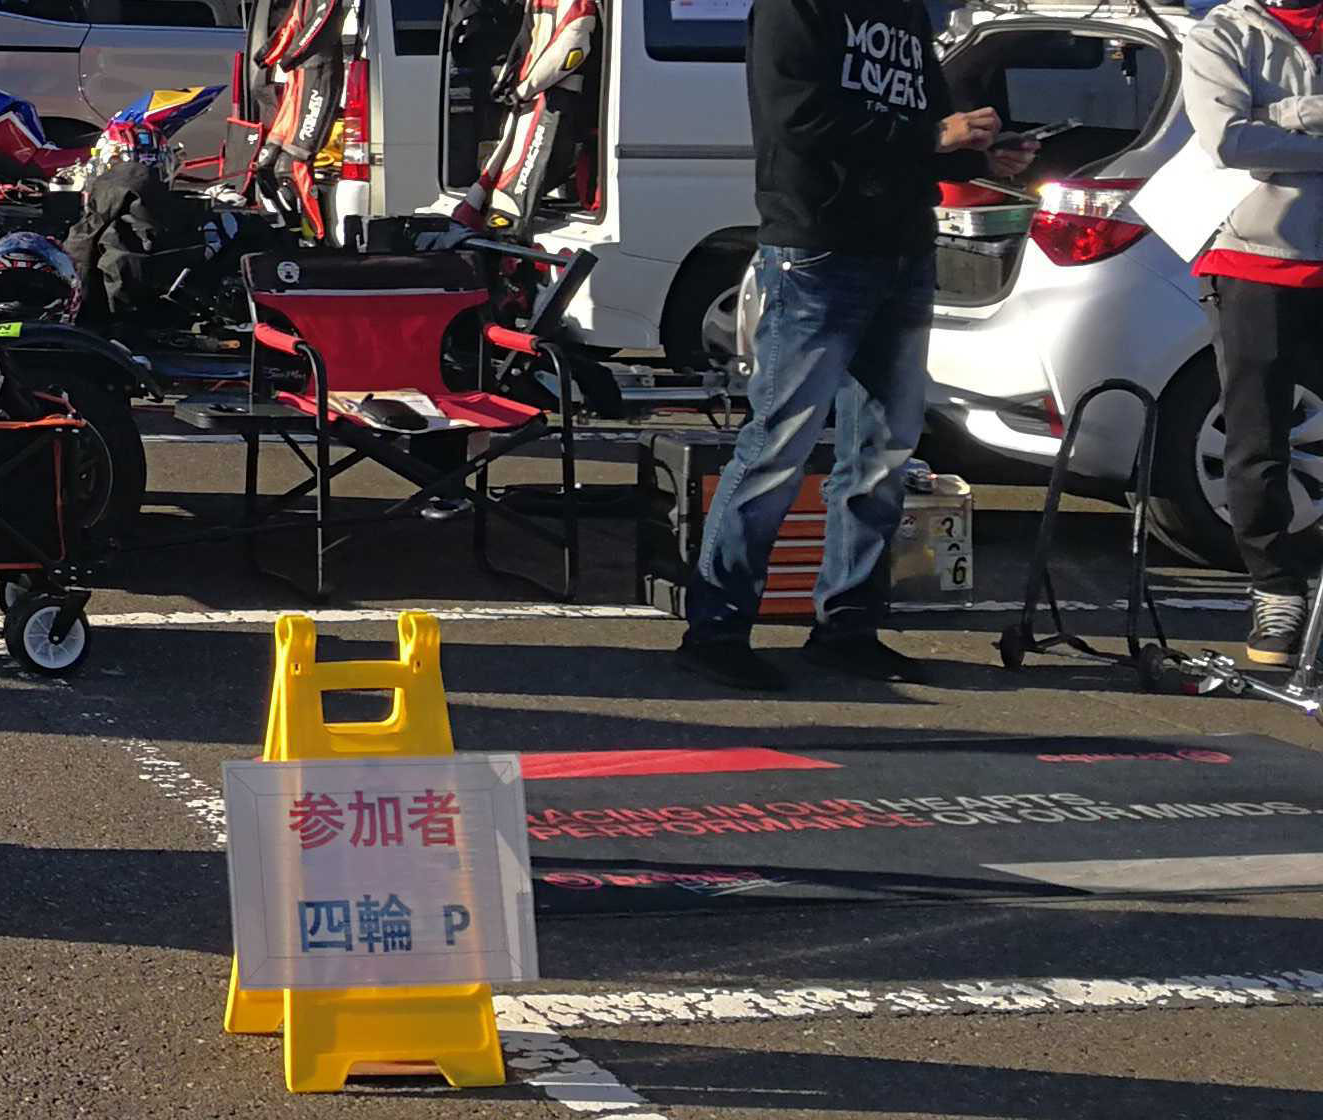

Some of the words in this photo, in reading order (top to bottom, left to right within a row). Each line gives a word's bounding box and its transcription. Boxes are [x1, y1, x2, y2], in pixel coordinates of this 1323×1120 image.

[289, 788, 461, 850] 参加者
[526, 813, 937, 841] PERFORMANCE
[931, 809, 1023, 826] ON
[1015, 805, 1143, 823] OUR
[1129, 801, 1323, 821] MINDS.
[703, 802, 767, 819] IN
[763, 798, 888, 818] OUR
[875, 792, 1112, 813] HEARTS.
[297, 893, 414, 954] 四輪
[442, 904, 472, 947] P
